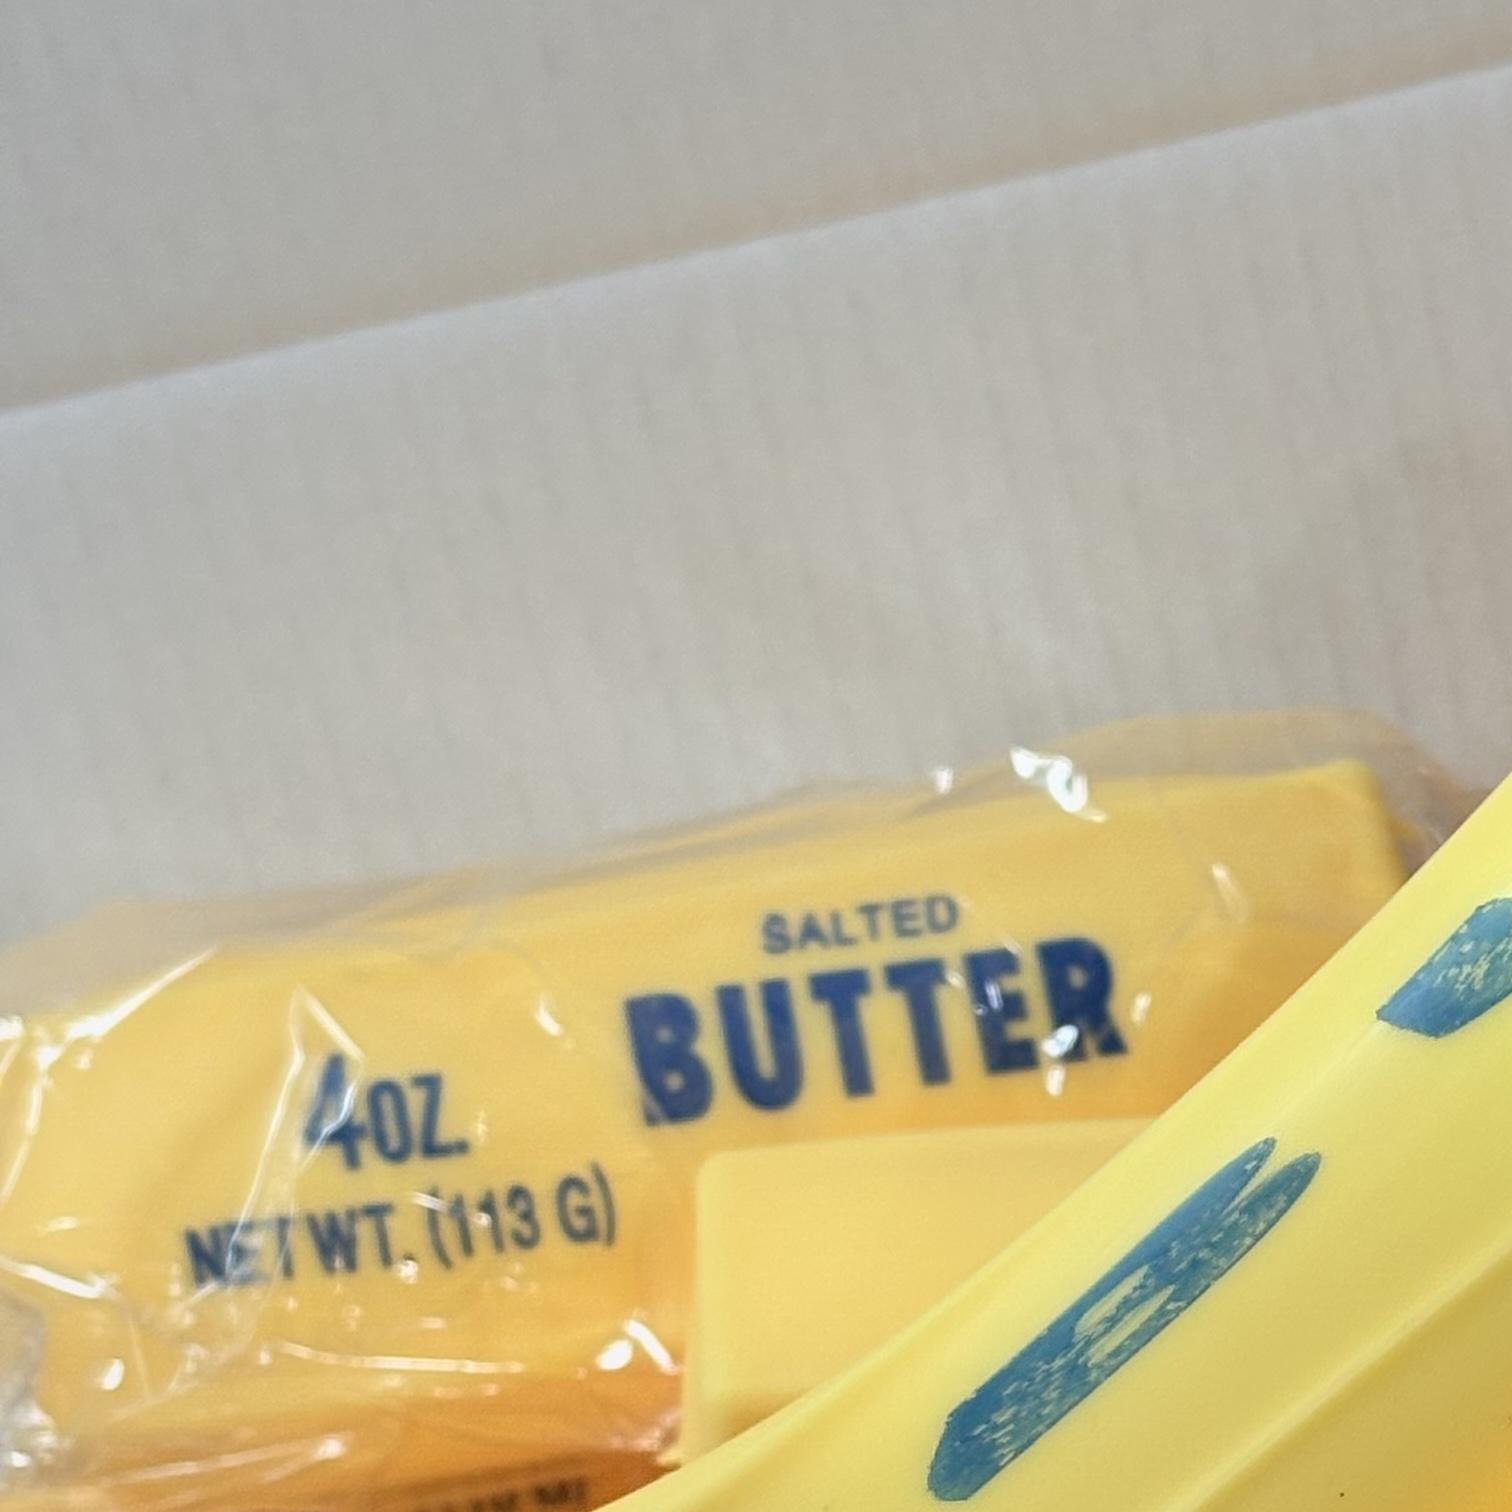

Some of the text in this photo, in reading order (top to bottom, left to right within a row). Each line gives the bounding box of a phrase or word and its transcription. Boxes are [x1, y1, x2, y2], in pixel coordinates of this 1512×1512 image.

[762, 895, 960, 953] SALTED
[625, 936, 1129, 1128] BUTTER
[185, 1215, 293, 1288] NET
[427, 1185, 541, 1268] (113
[556, 1162, 616, 1247] G)
